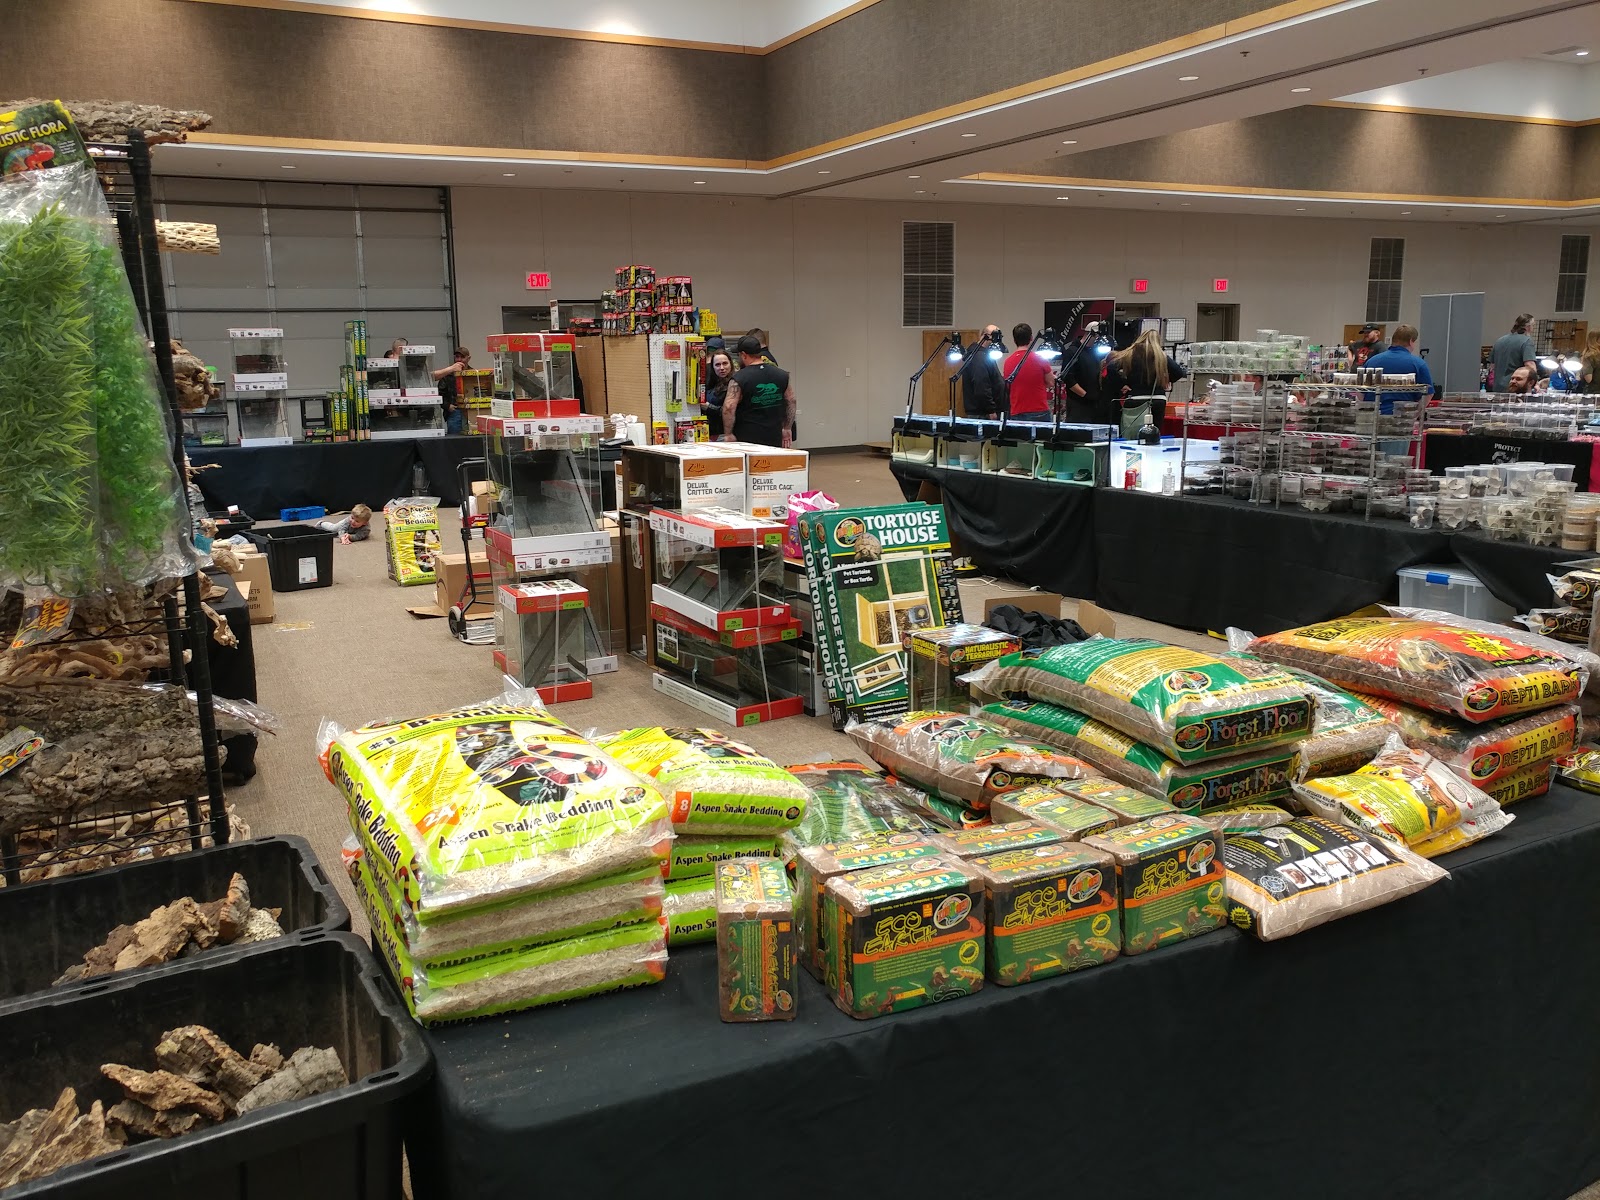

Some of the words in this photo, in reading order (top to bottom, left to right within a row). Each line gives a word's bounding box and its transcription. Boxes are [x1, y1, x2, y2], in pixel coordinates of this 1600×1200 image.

[28, 119, 68, 139] FLORA
[530, 273, 548, 287] EXIT
[1135, 279, 1148, 291] EXIT
[1216, 280, 1228, 291] EXIT
[1494, 443, 1522, 453] PROTECT
[863, 510, 941, 530] TORTOISE
[878, 525, 939, 546] HOUSE
[803, 539, 825, 632] TORTOISE
[818, 634, 838, 699] HOUSE
[820, 543, 843, 637] TORTOISE
[836, 639, 855, 704] HOUSE
[965, 641, 1009, 654] NATURALISTIC
[965, 649, 1001, 660] TERRARIUM
[1500, 685, 1539, 706] REPTI
[1541, 679, 1577, 699] BARK
[1210, 716, 1260, 742] Forest
[1262, 706, 1304, 732] Floor
[1501, 743, 1538, 769] REPTI
[1540, 729, 1573, 754] BARK
[1207, 776, 1251, 801] Forest
[1488, 784, 1515, 803] EPTI
[679, 799, 689, 811] 8
[694, 803, 721, 813] Aspen
[722, 803, 748, 814] Snake
[749, 805, 784, 817] Bedding
[368, 813, 401, 873] Bedding
[675, 855, 703, 866] Aspen
[706, 852, 732, 863] Snake
[1143, 857, 1179, 883] ECO
[1133, 869, 1190, 900] EARTH
[1014, 886, 1057, 911] ECO
[876, 911, 921, 937] ECO
[1004, 899, 1072, 929] EARTH
[674, 922, 703, 934] Aspen
[767, 924, 779, 954] ECO
[863, 925, 937, 956] EARTH
